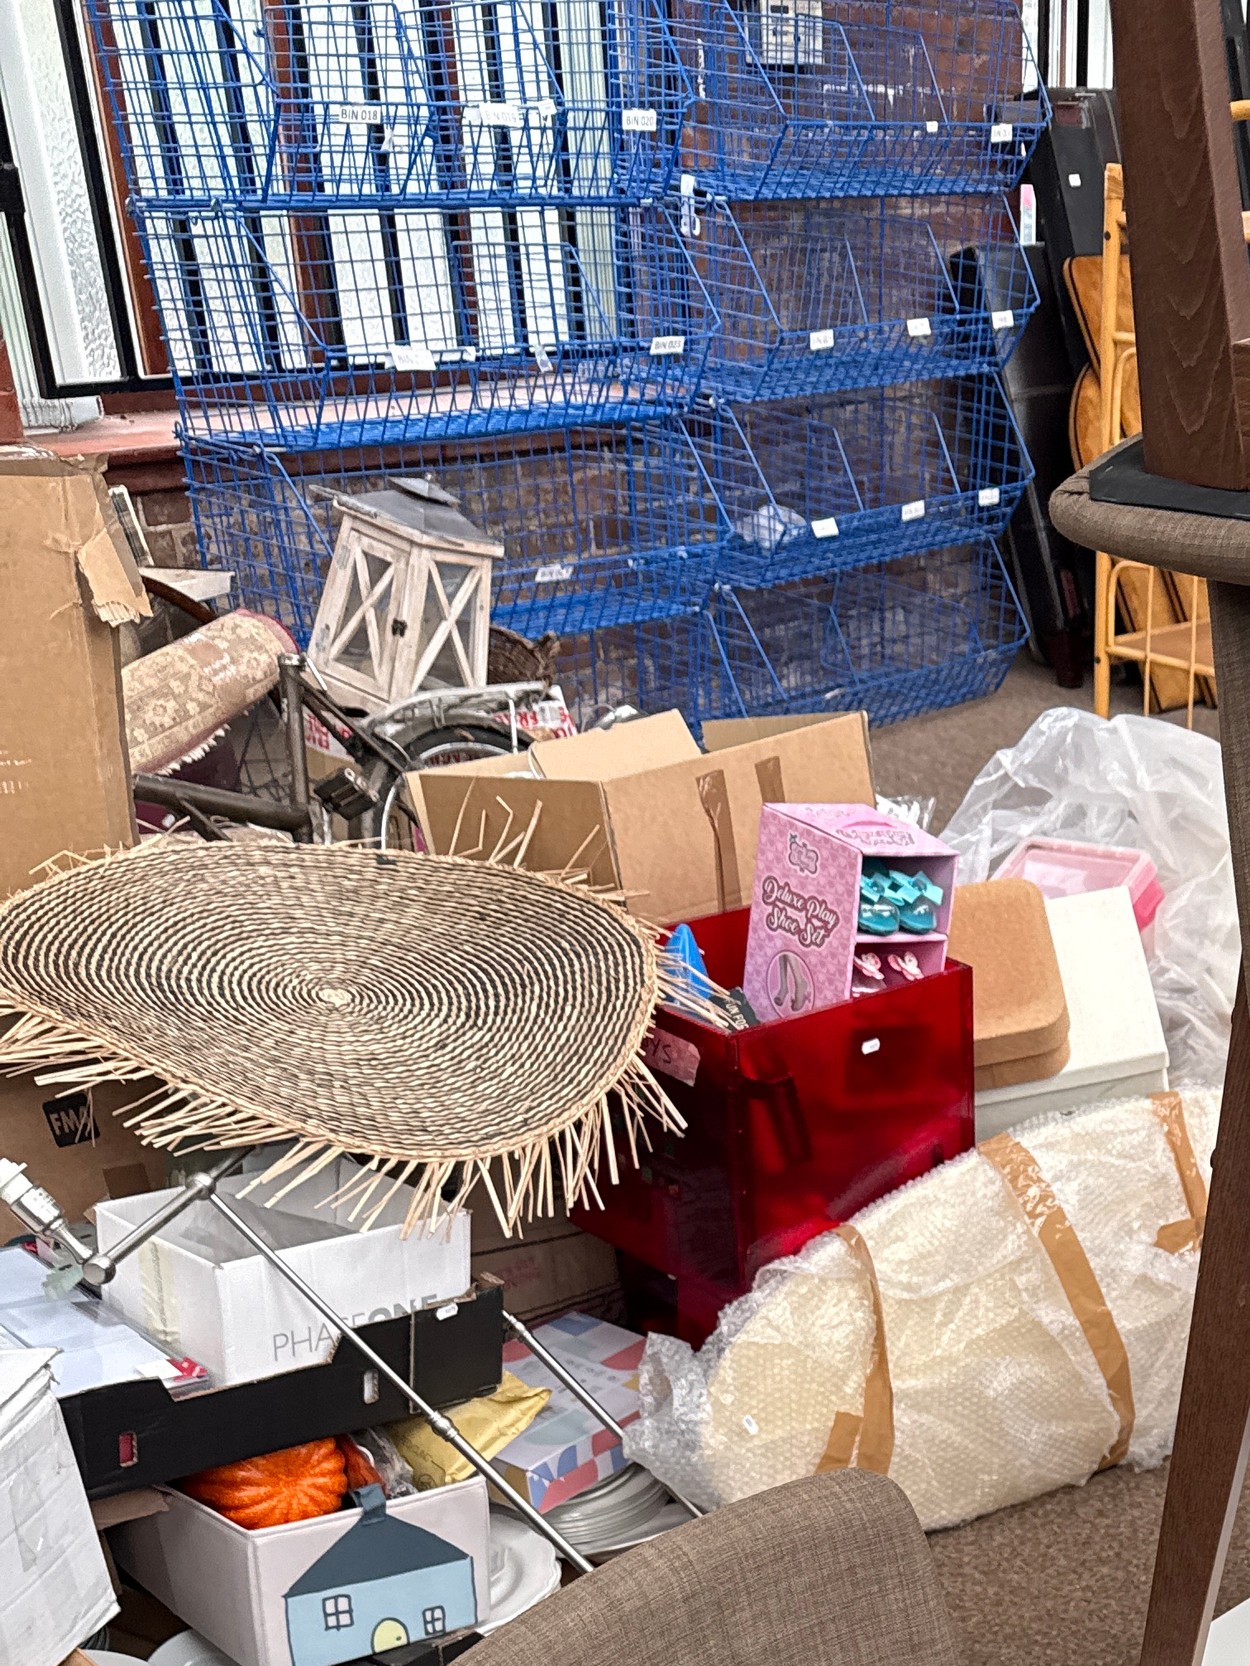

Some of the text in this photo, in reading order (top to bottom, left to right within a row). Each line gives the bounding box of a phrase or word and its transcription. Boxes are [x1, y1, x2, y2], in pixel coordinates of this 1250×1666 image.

[341, 108, 378, 121] BIN 018
[484, 110, 500, 122] BN
[626, 115, 654, 126] BIN 020
[763, 878, 837, 929] Deluxe Play
[766, 905, 826, 945] Shoe Set
